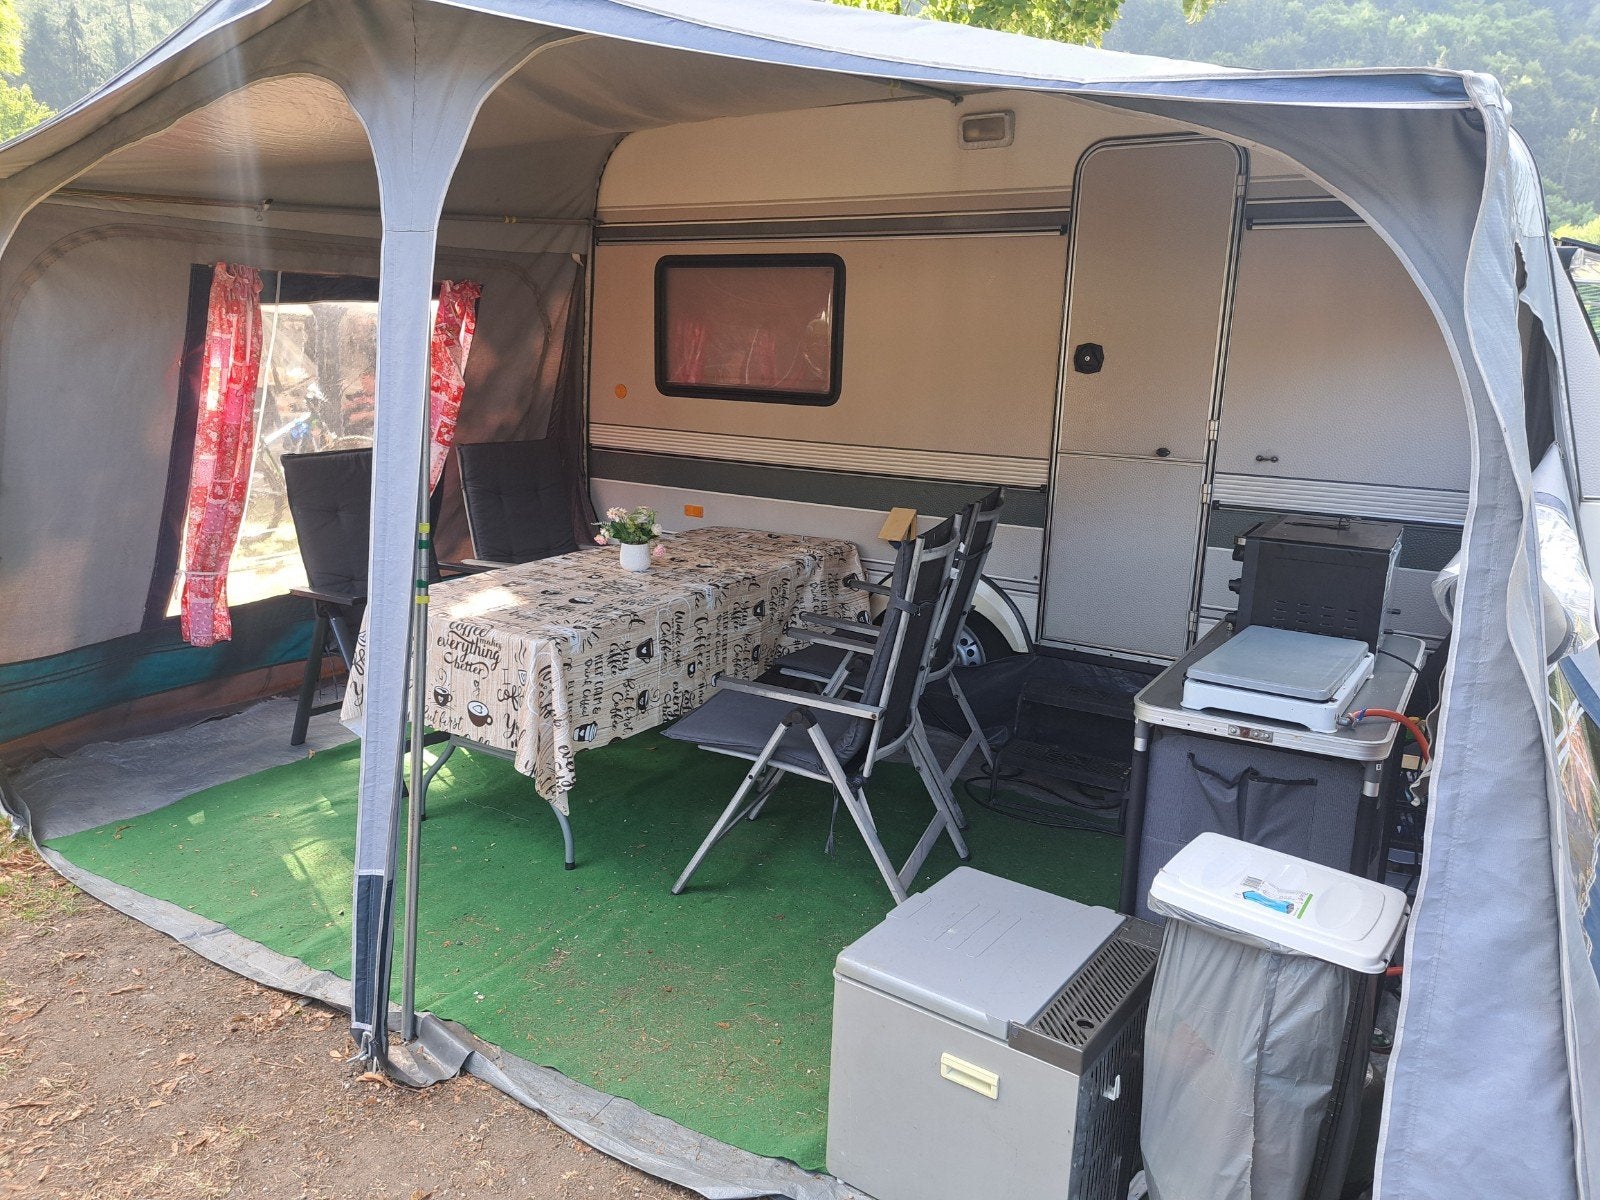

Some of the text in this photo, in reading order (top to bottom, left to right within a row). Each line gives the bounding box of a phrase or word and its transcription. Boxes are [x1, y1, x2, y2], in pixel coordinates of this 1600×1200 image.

[449, 621, 494, 638] coffee
[437, 630, 502, 671] everything
[444, 651, 490, 680] better
